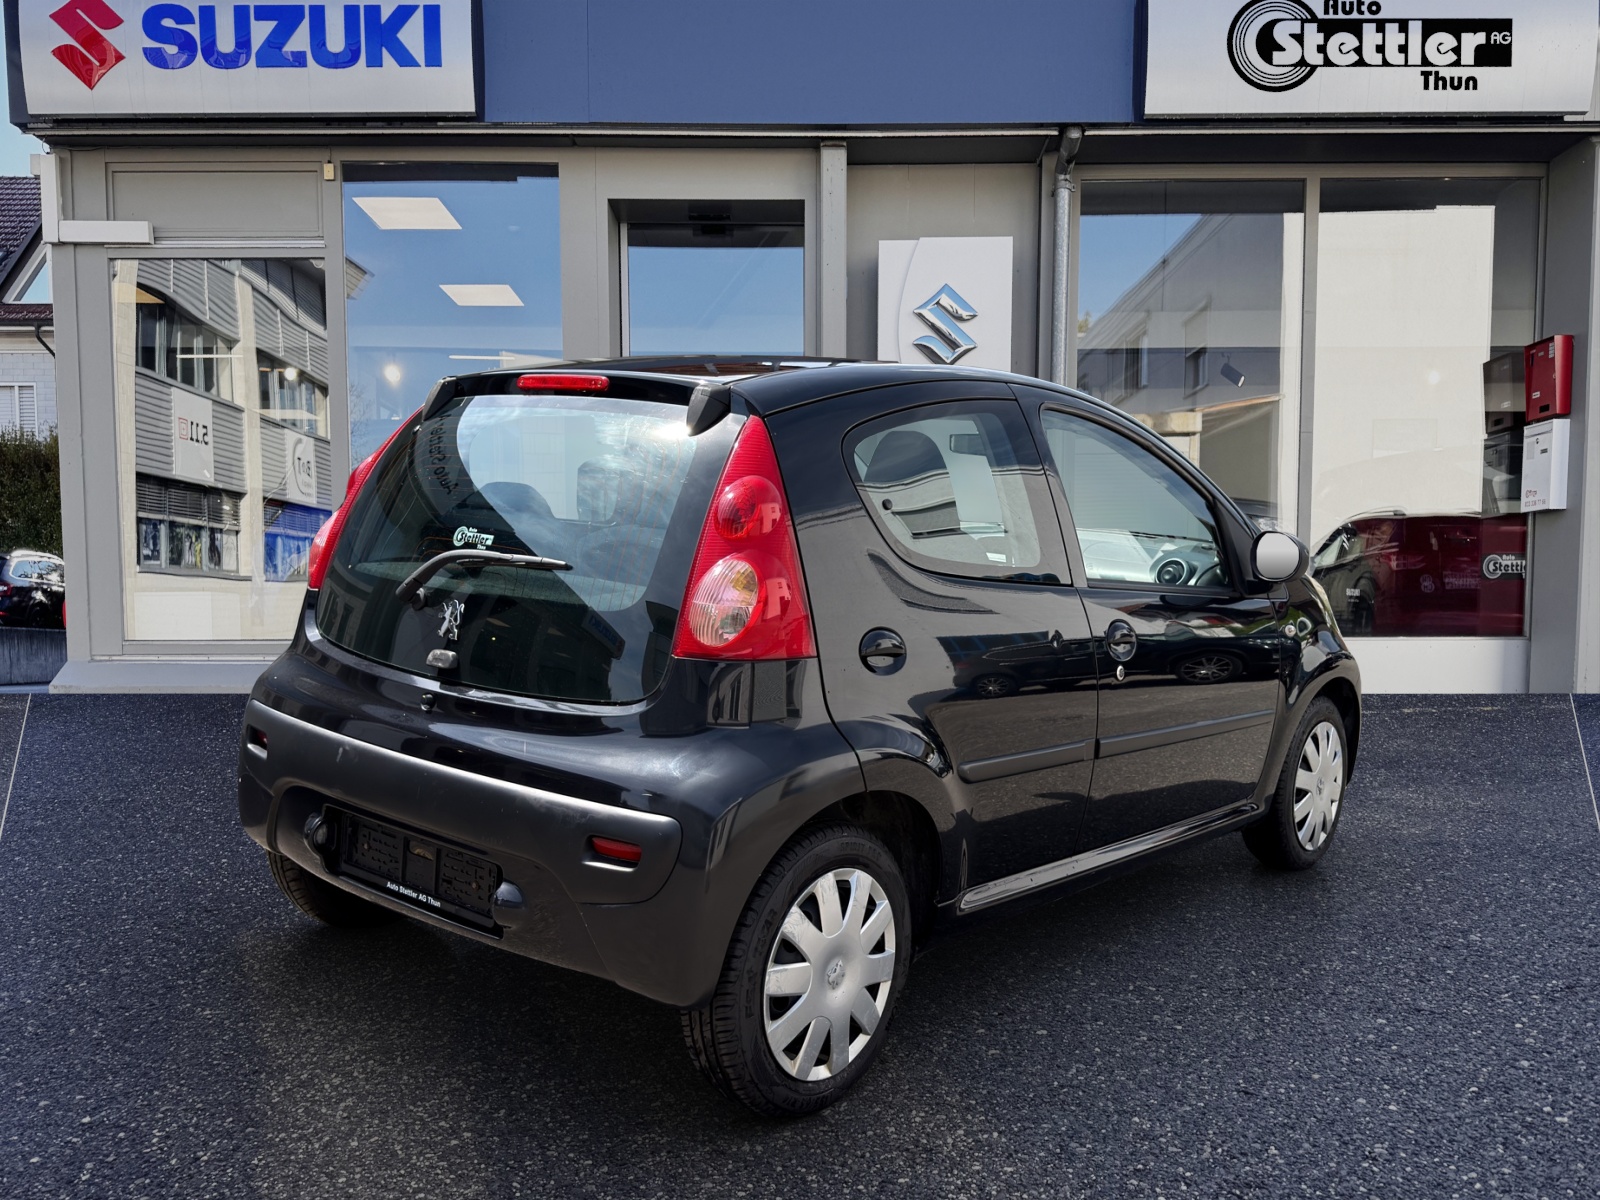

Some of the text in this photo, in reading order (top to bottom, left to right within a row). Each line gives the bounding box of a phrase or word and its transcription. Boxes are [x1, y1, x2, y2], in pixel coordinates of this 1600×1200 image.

[1323, 0, 1382, 16] Auto
[141, 3, 443, 70] SUZUKI
[1272, 20, 1512, 66] Stettler AG
[1420, 70, 1478, 91] Thun
[1492, 561, 1526, 573] Stettl
[386, 881, 399, 891] Auto
[418, 893, 427, 902] AG
[427, 896, 441, 908] Thun
